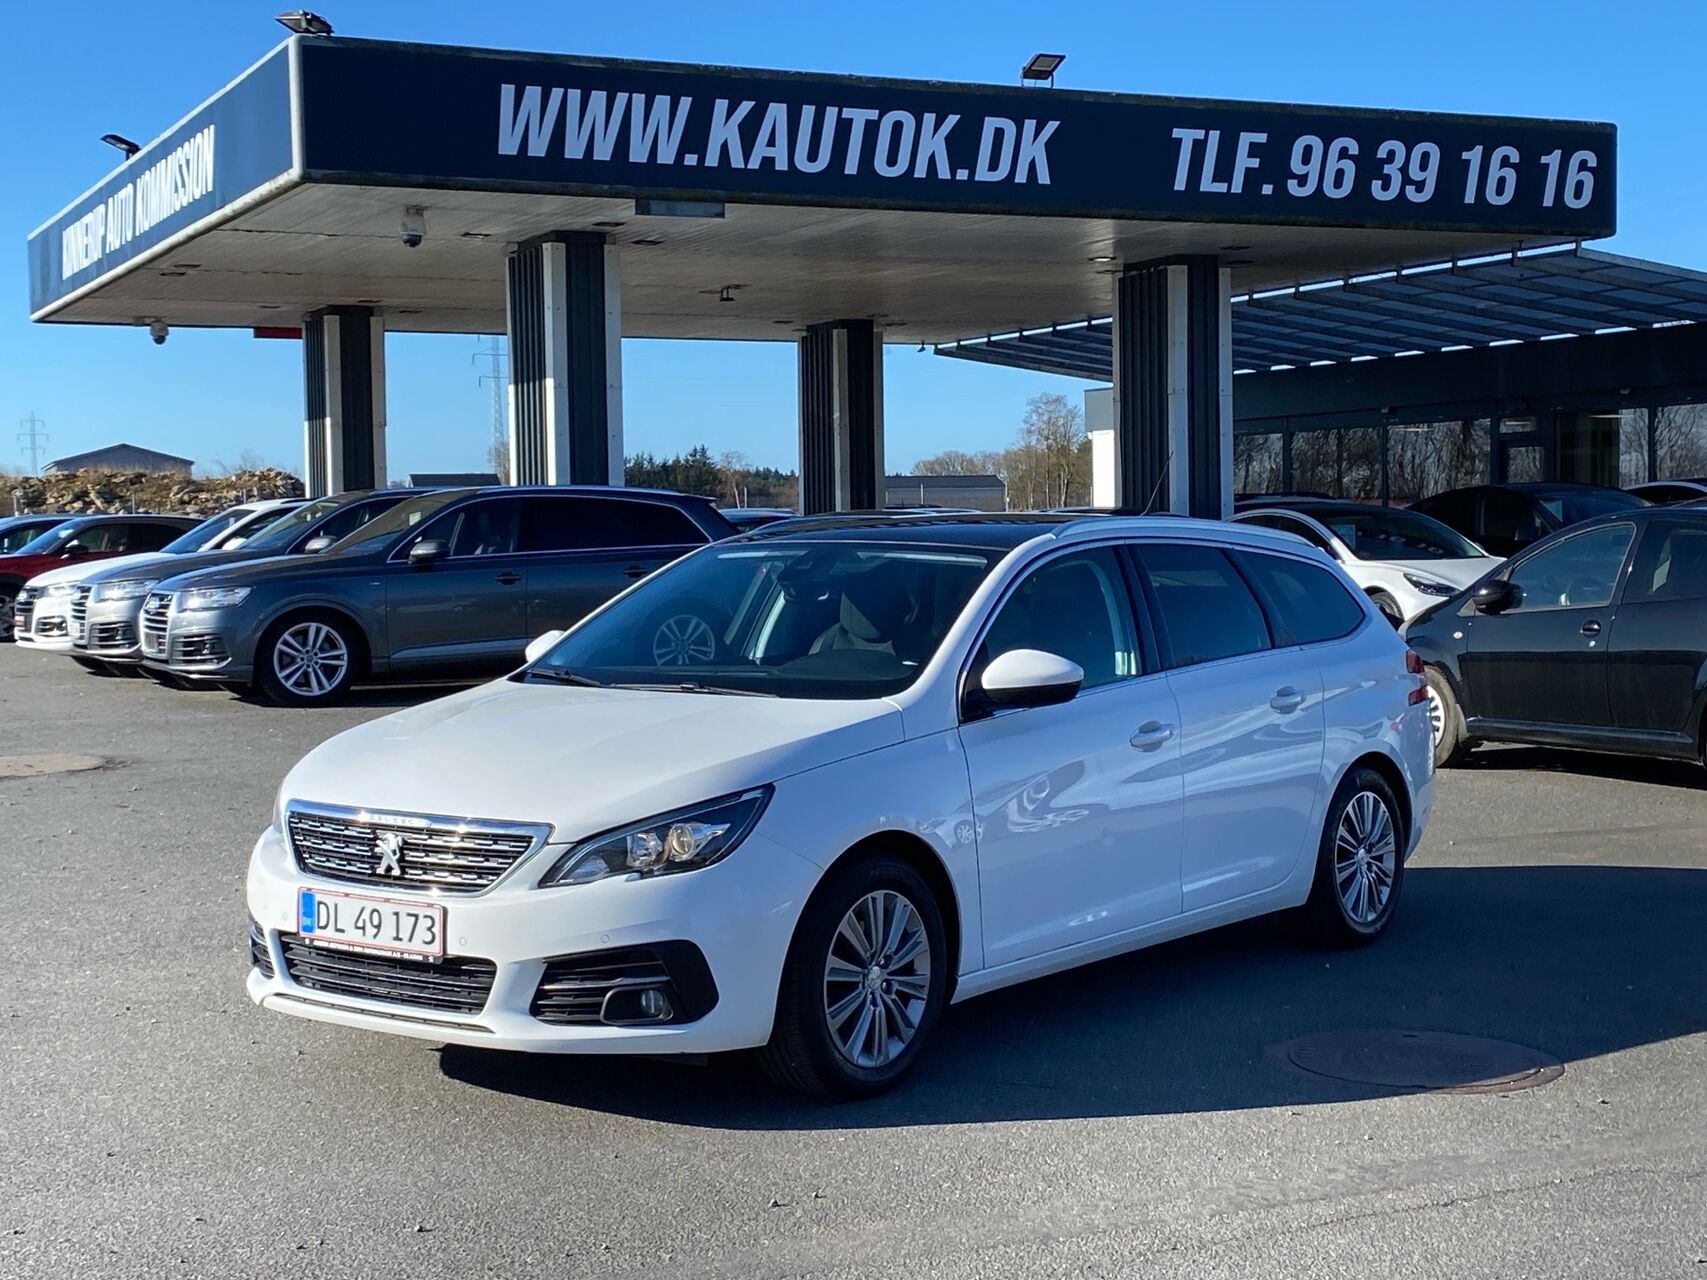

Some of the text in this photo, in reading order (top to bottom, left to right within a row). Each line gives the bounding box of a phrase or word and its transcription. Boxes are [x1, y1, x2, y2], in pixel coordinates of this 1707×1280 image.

[498, 83, 1060, 185] WWW.KAUTOK.DK
[1171, 127, 1598, 209] TLF. 96 39 16 16
[106, 182, 134, 254] AUTO
[135, 124, 215, 237] KOMMISSION
[316, 900, 437, 945] DL 49 173
